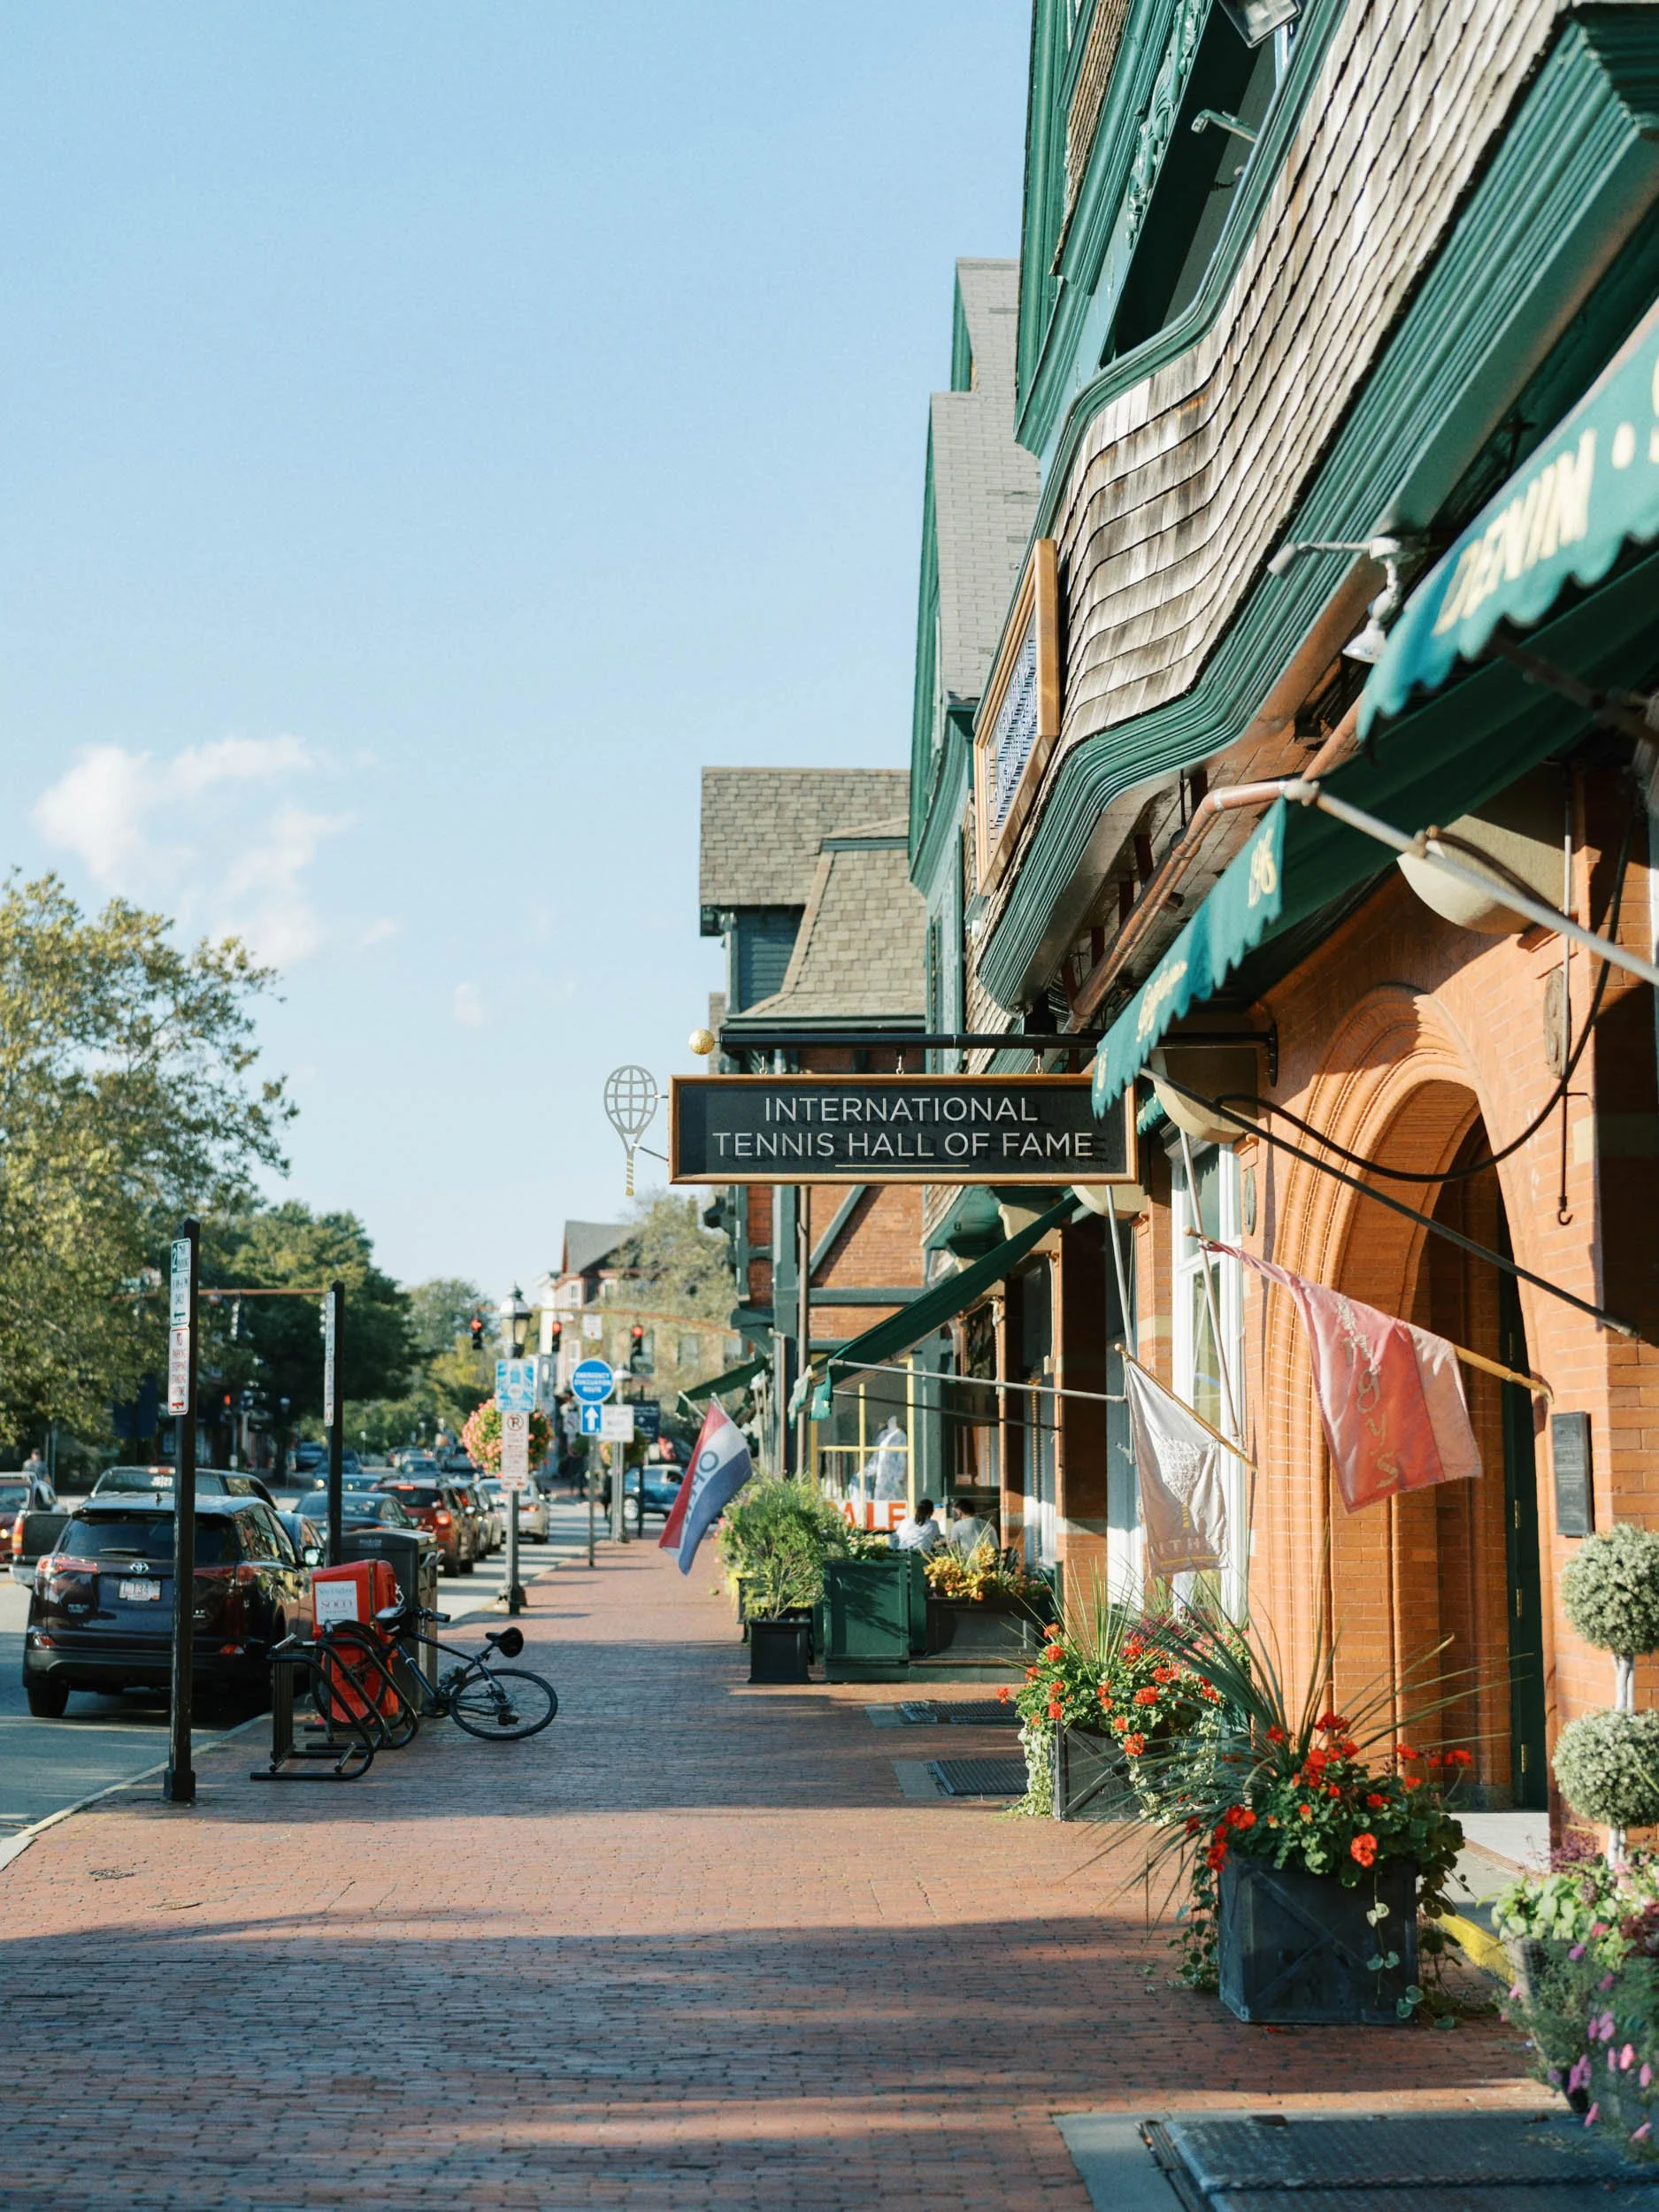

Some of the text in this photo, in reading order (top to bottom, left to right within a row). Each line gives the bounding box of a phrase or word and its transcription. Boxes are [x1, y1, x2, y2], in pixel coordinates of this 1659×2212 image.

[765, 1096, 1038, 1122] INTERNATIONAL
[712, 1132, 1094, 1156] TENNIS HALL OF FAME
[826, 1500, 907, 1532] ALE
